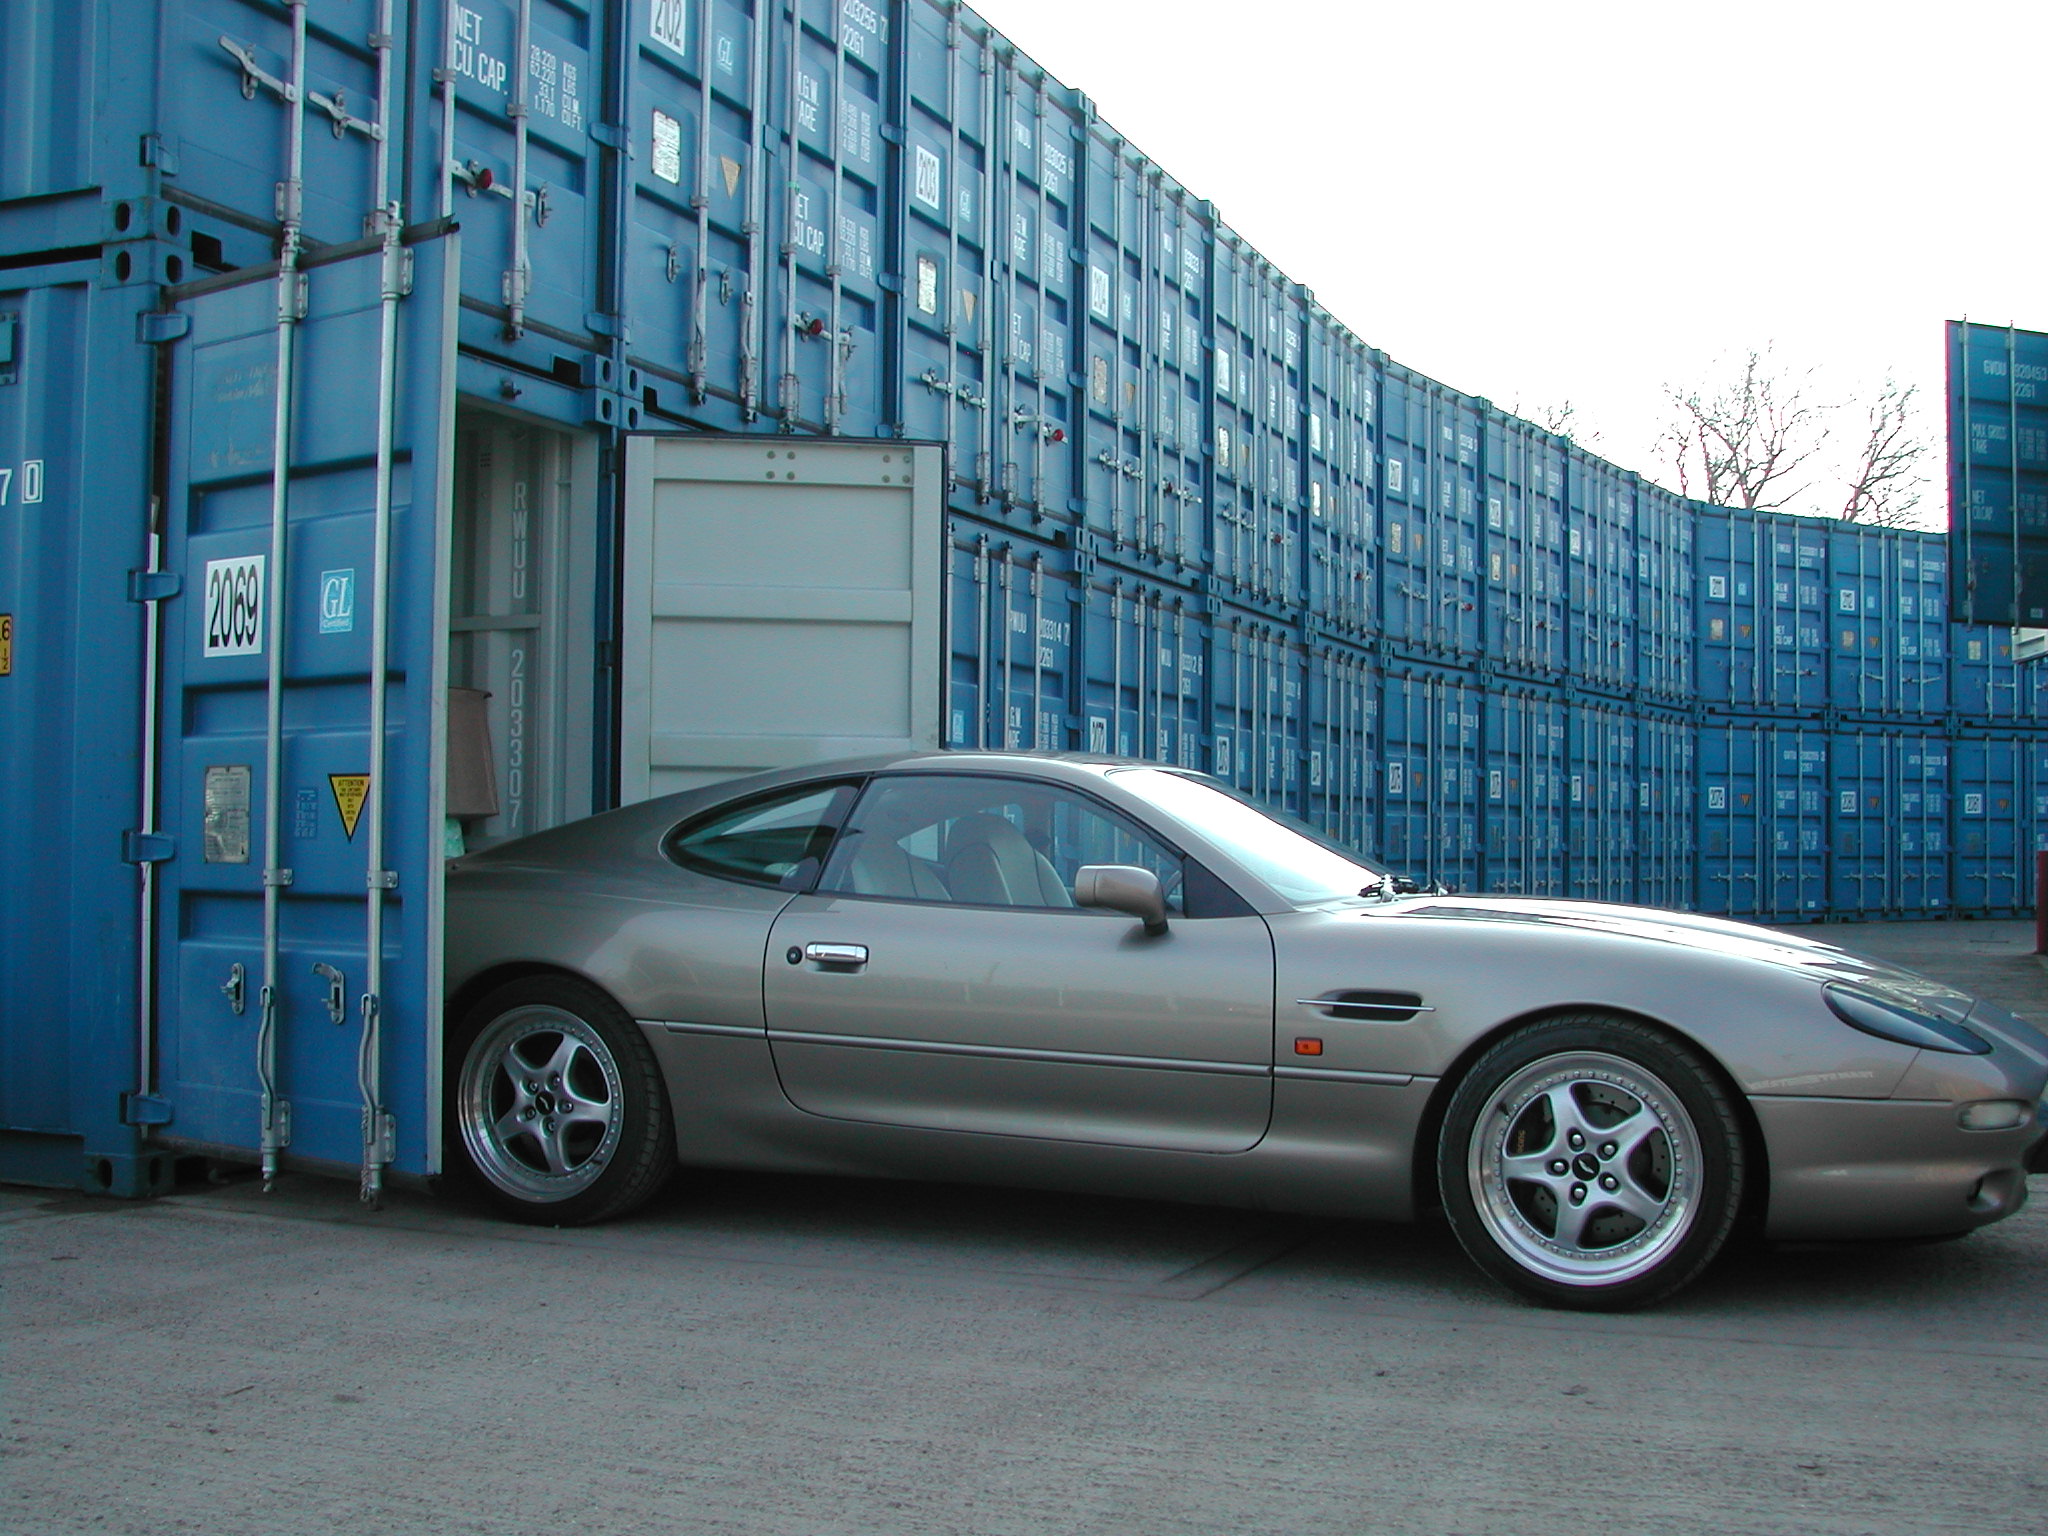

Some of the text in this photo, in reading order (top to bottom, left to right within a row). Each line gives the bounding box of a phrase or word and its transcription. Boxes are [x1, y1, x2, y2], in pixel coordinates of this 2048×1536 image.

[454, 4, 482, 45] NET
[453, 40, 508, 96] CU. CAP.
[208, 564, 258, 648] 2069
[323, 577, 349, 618] GL
[509, 649, 525, 828] 203307
